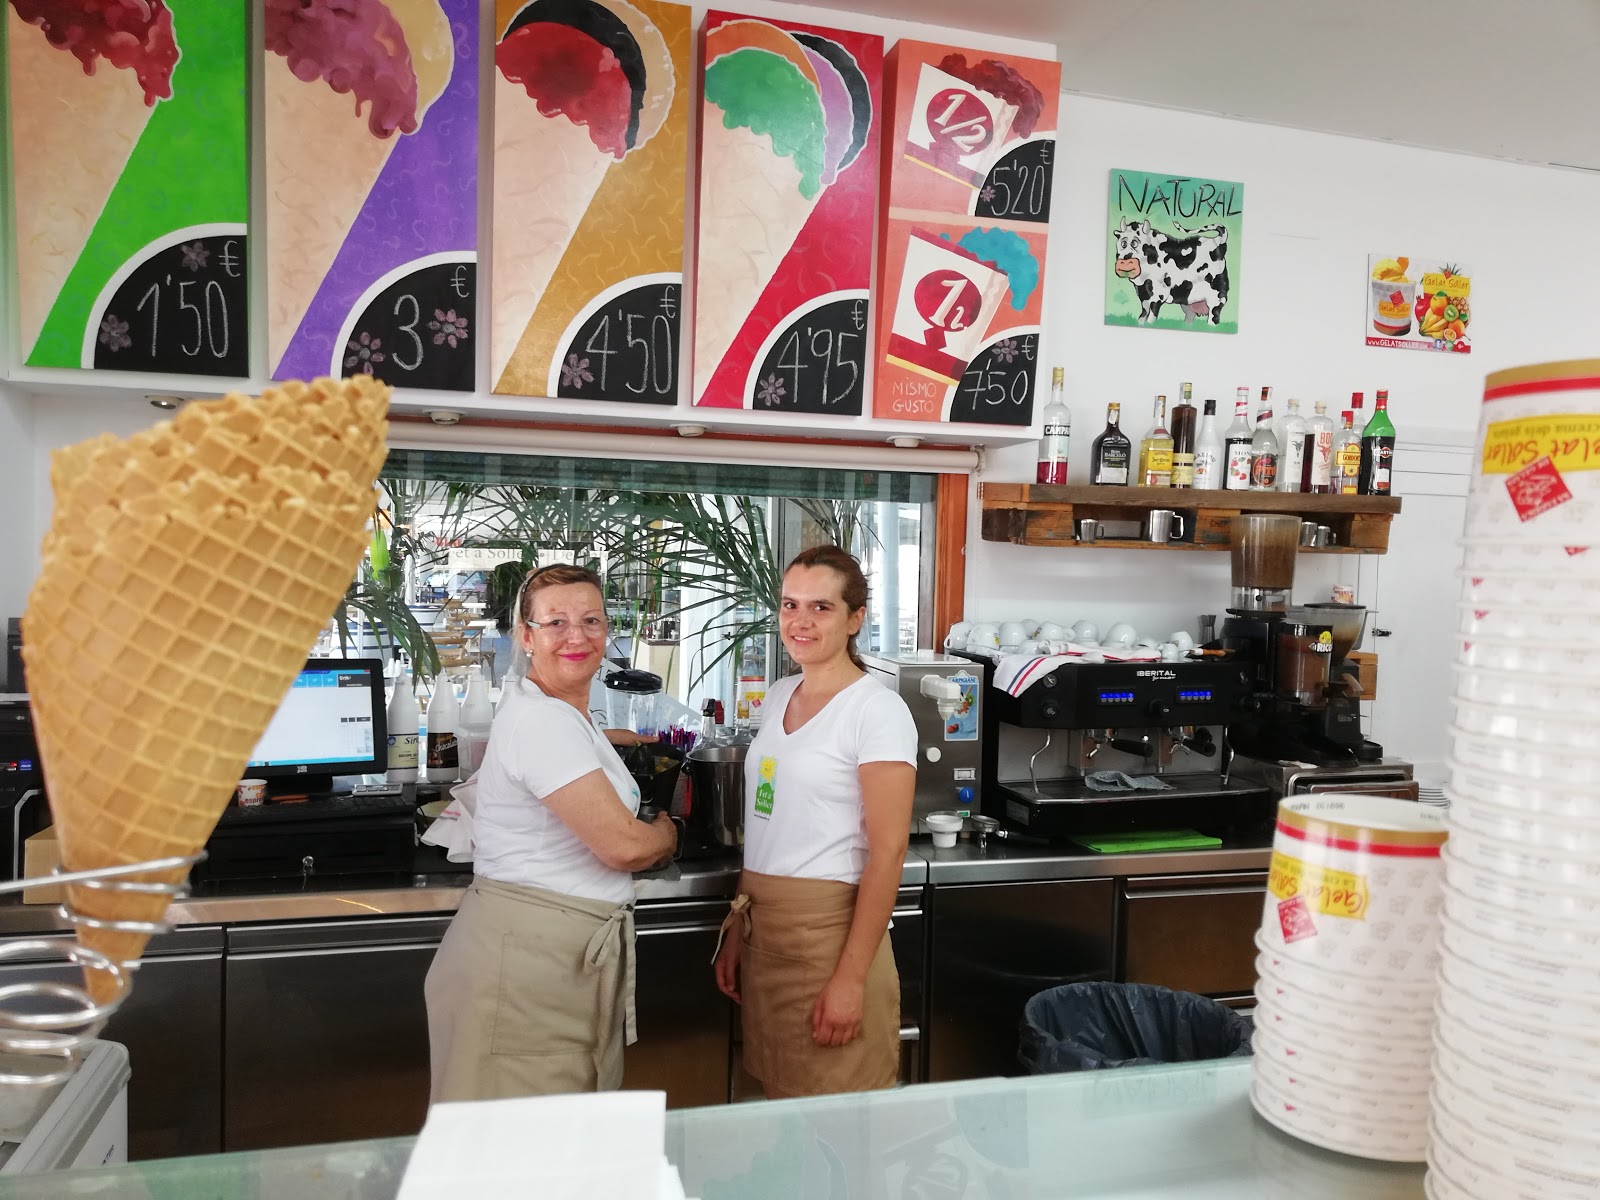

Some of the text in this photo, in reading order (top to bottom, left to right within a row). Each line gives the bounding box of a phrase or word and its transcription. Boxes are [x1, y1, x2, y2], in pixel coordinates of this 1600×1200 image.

[1117, 174, 1242, 219] NATURAL
[391, 293, 424, 371] 3
[892, 399, 935, 413] GUSTO
[1045, 425, 1070, 436] CAMPA
